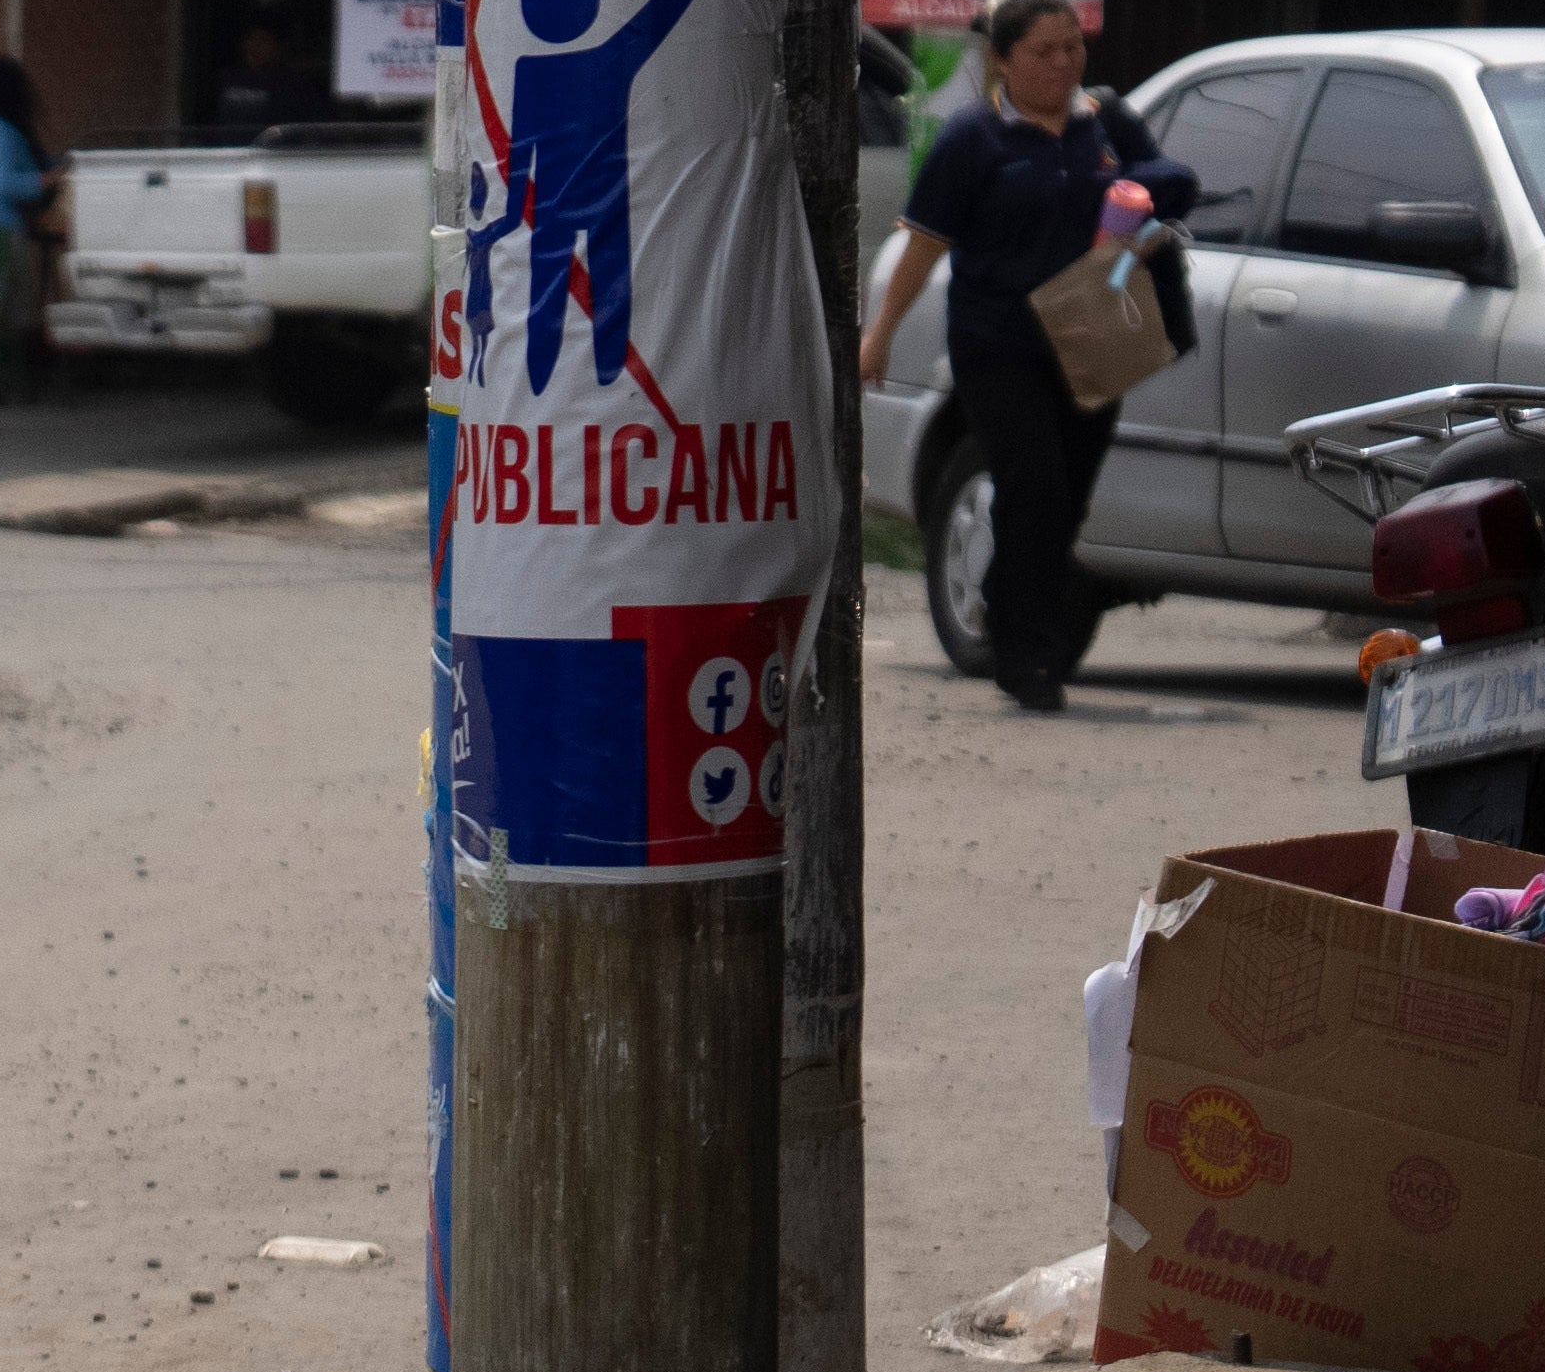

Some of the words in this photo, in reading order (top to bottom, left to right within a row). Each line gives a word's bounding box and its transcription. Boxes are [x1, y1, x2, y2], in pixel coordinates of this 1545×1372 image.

[430, 288, 463, 380] S
[1388, 1173, 1460, 1207] HACCP
[1183, 1206, 1337, 1287] Assorted
[1304, 1300, 1367, 1341] FRUTA
